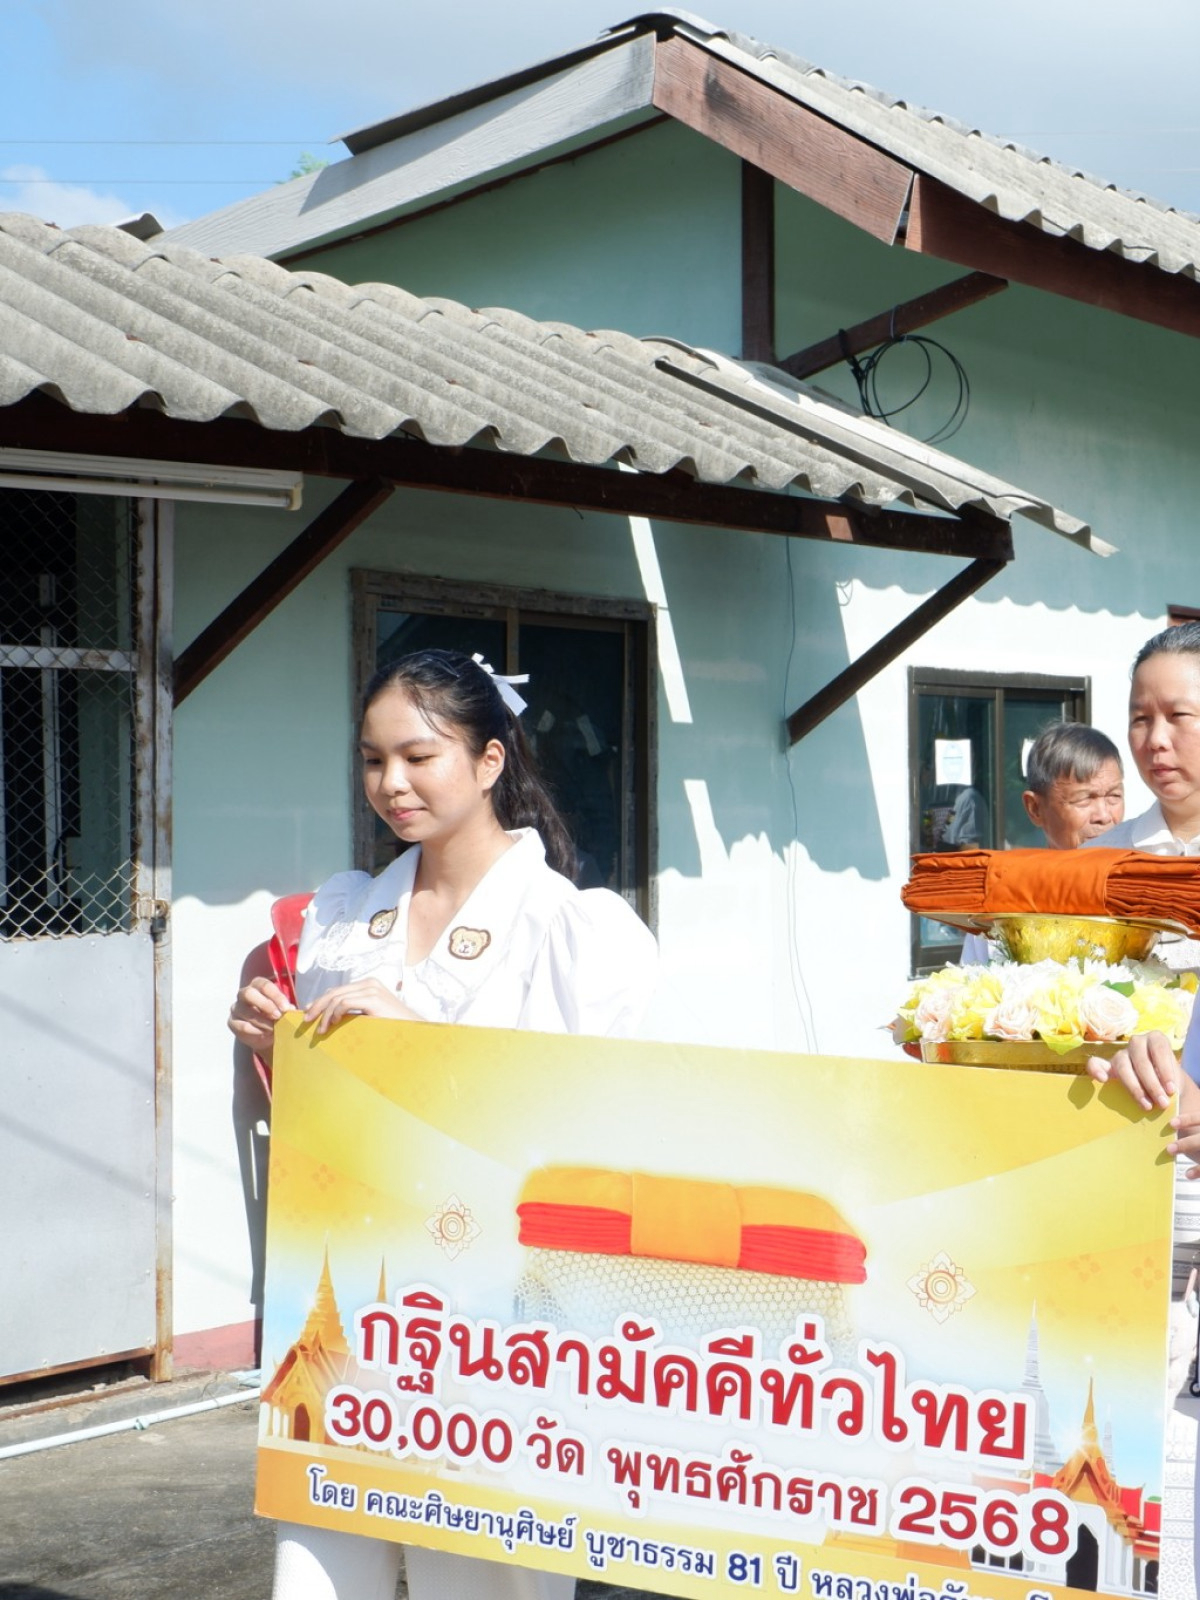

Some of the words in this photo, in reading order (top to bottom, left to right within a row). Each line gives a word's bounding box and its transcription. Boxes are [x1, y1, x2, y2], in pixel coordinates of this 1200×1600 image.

[360, 1291, 1026, 1460] กฐินสามัคคีทั่วไทย
[308, 1466, 355, 1509] โดย
[365, 1491, 577, 1551] คณะศิษยานุศิษย์
[585, 1531, 714, 1576] บูชาธรรม
[727, 1552, 762, 1585] 81
[776, 1555, 798, 1590] ปี
[331, 1393, 513, 1464] 30,000
[526, 1415, 585, 1476] วัด
[607, 1446, 878, 1527] พุทธศักราช
[898, 1486, 1071, 1555] 2568
